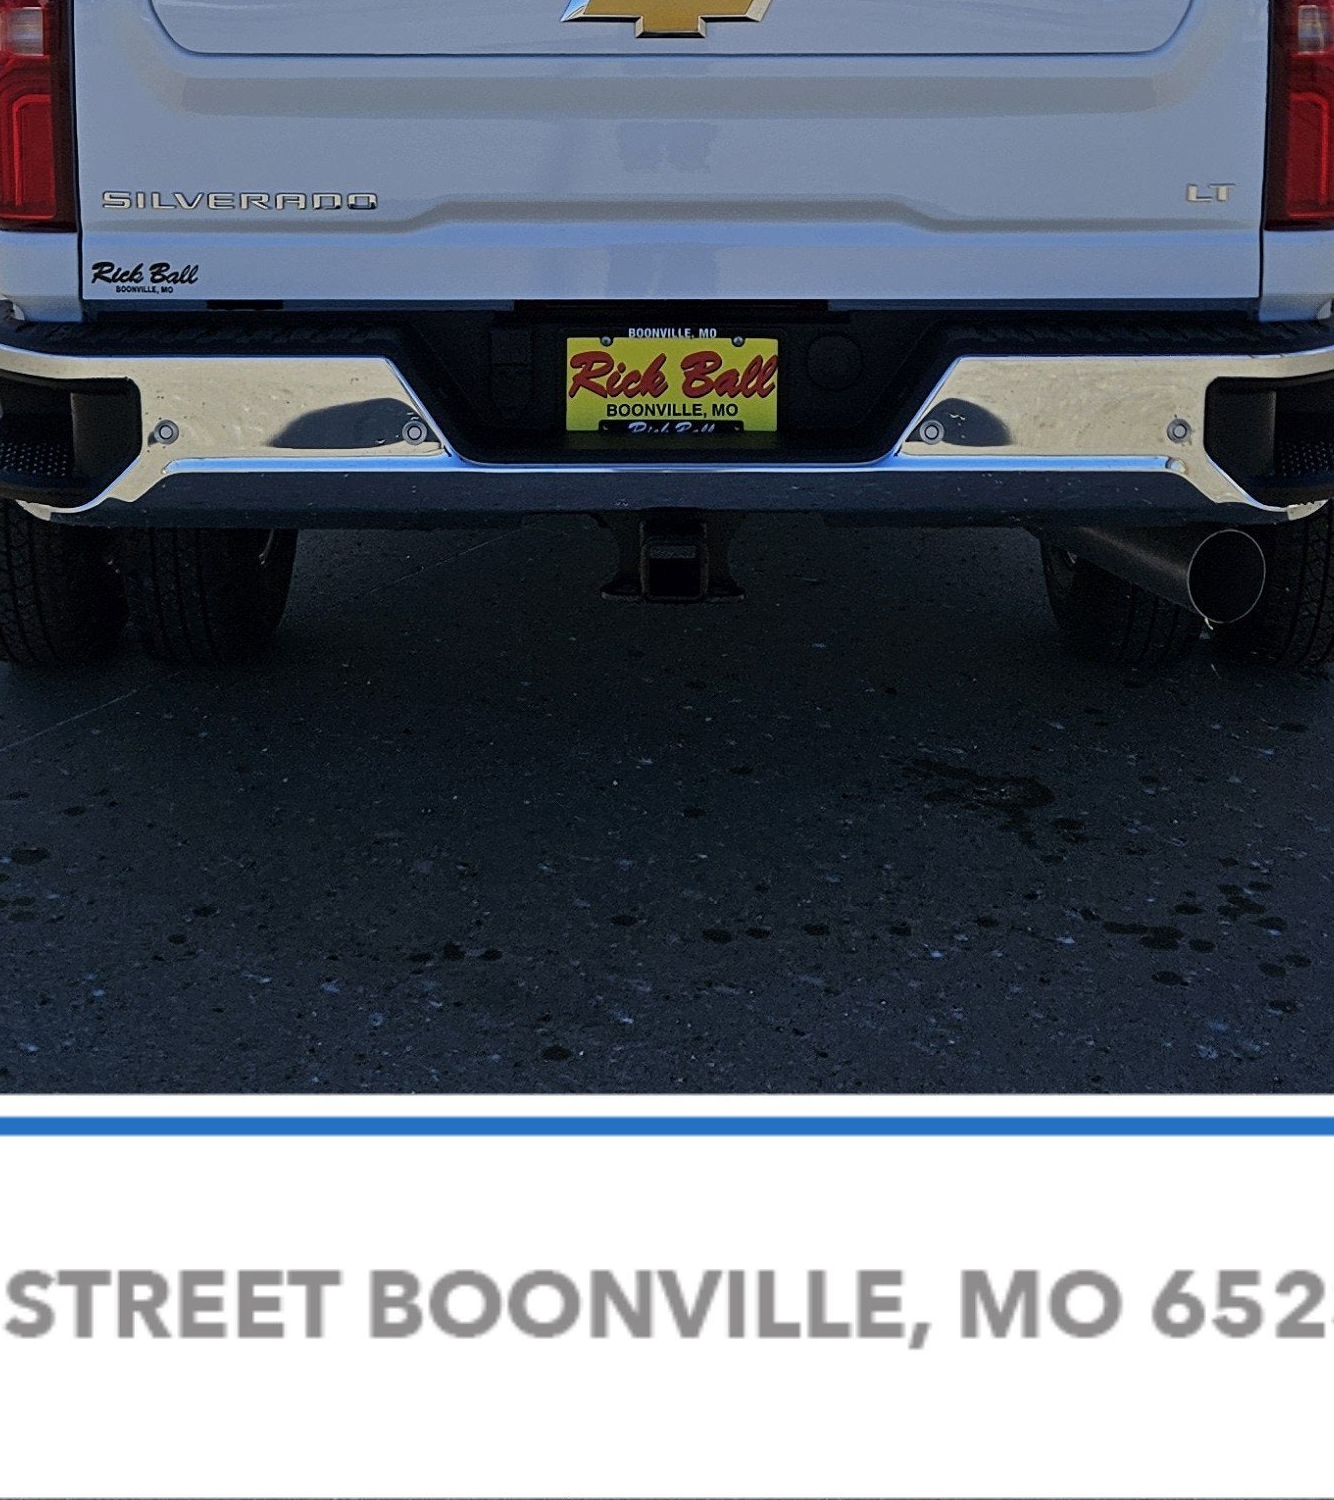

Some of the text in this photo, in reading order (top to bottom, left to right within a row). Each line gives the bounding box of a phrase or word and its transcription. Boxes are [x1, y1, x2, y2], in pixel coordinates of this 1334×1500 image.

[102, 190, 379, 210] SILVERADO
[1186, 182, 1236, 202] LT
[91, 261, 199, 285] Rick Ball
[115, 285, 174, 295] BOONVILLE, MO
[628, 328, 717, 339] BOONVILLE, MO
[568, 350, 779, 399] Rick Ball
[606, 403, 739, 419] BOONVILLE, MO
